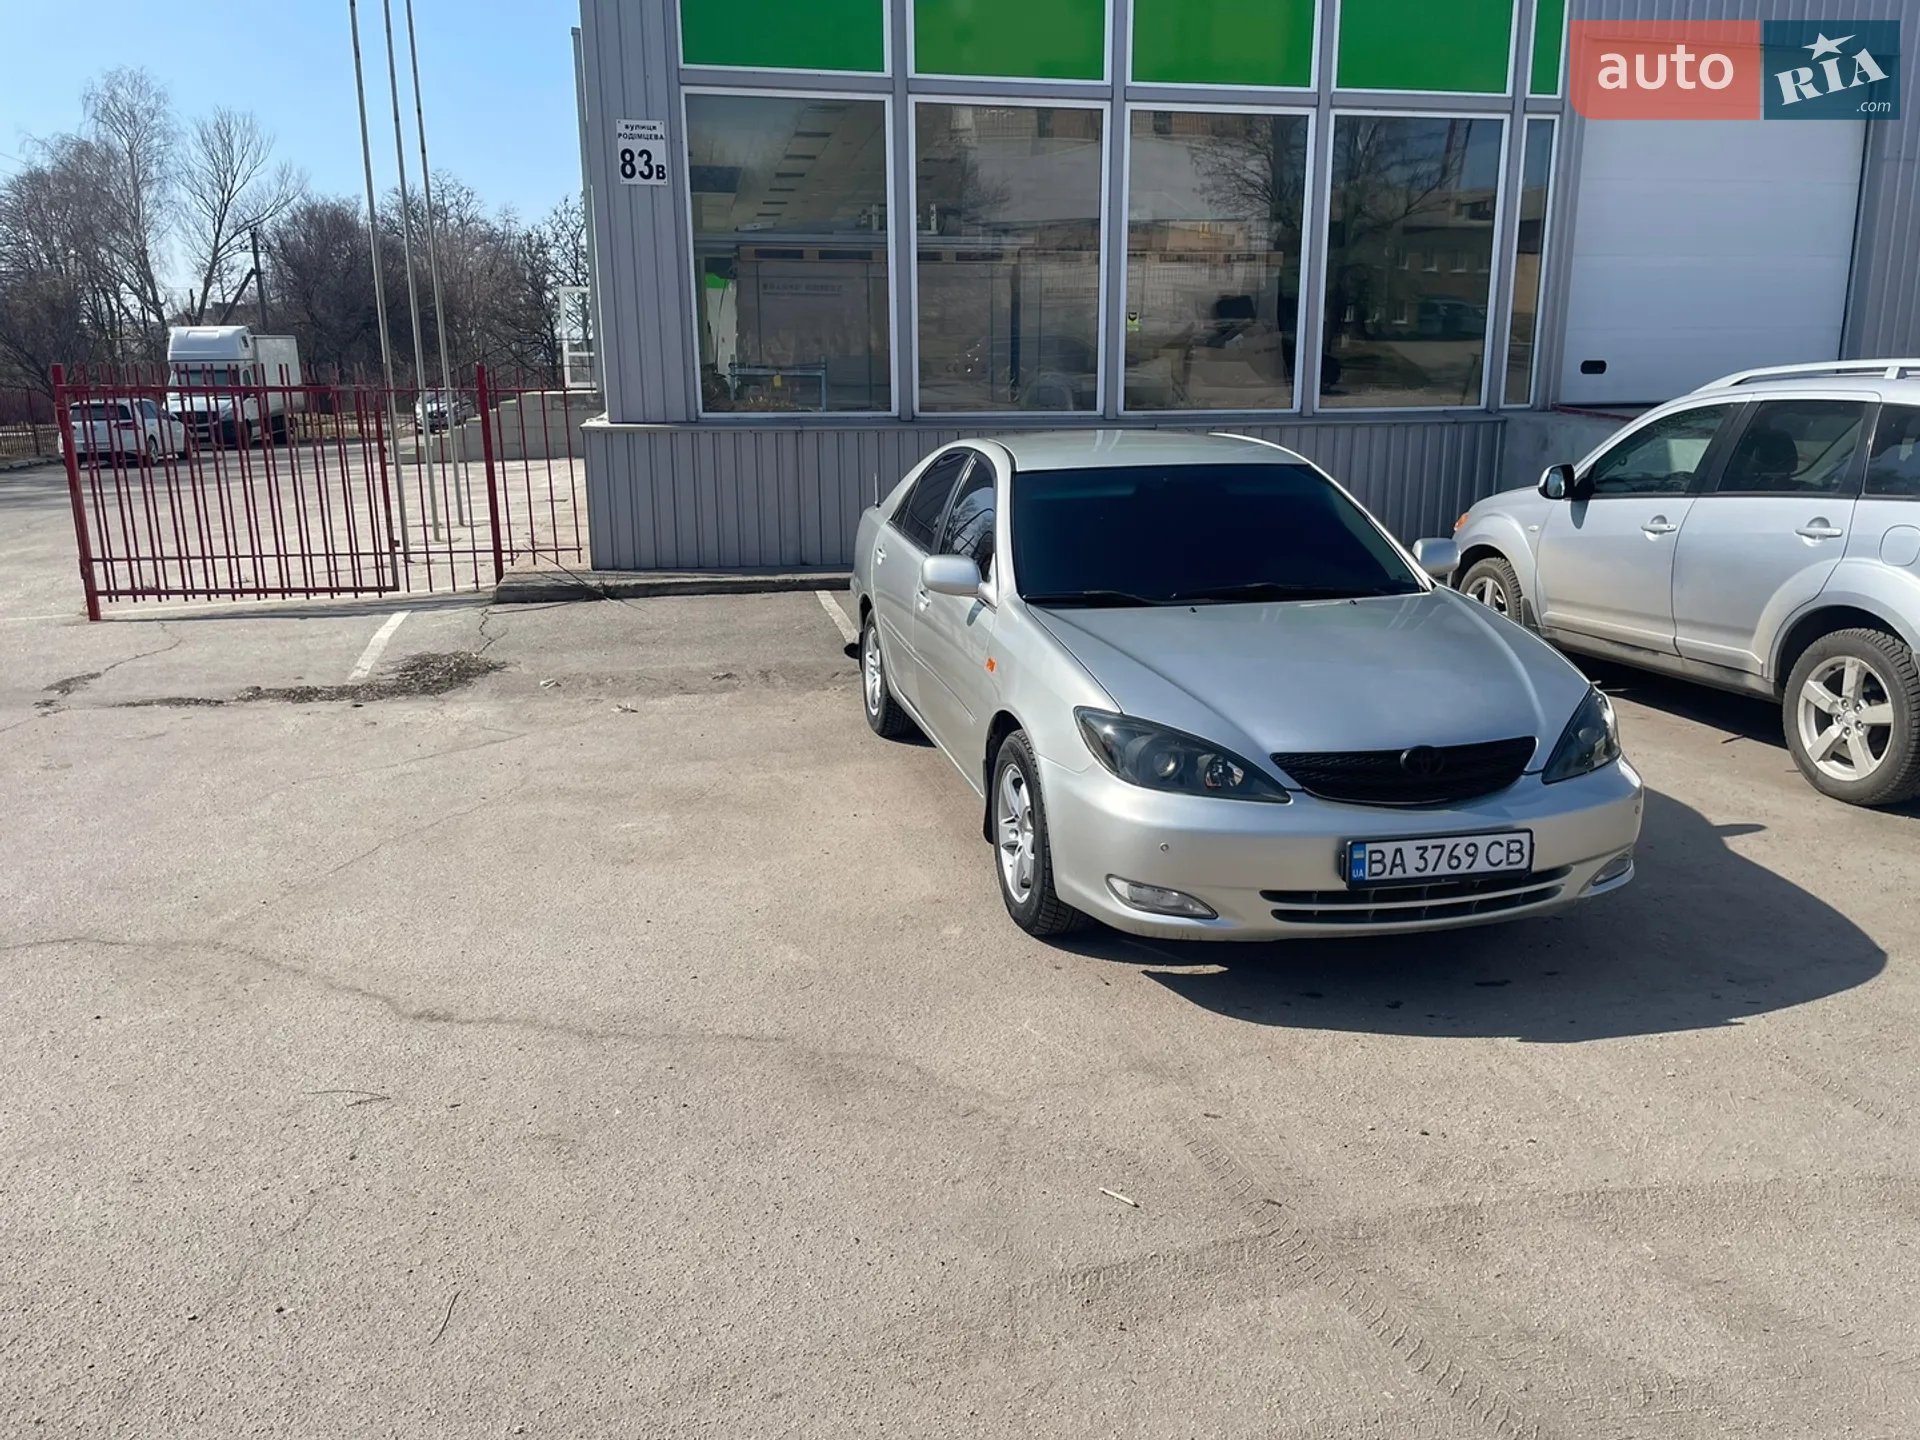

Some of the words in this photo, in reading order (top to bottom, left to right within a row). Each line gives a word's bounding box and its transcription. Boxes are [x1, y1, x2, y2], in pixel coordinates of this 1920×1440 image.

[1368, 847, 1407, 877] BA
[1414, 842, 1479, 873] 3769
[1485, 839, 1525, 867] CB
[1352, 869, 1364, 878] UA
